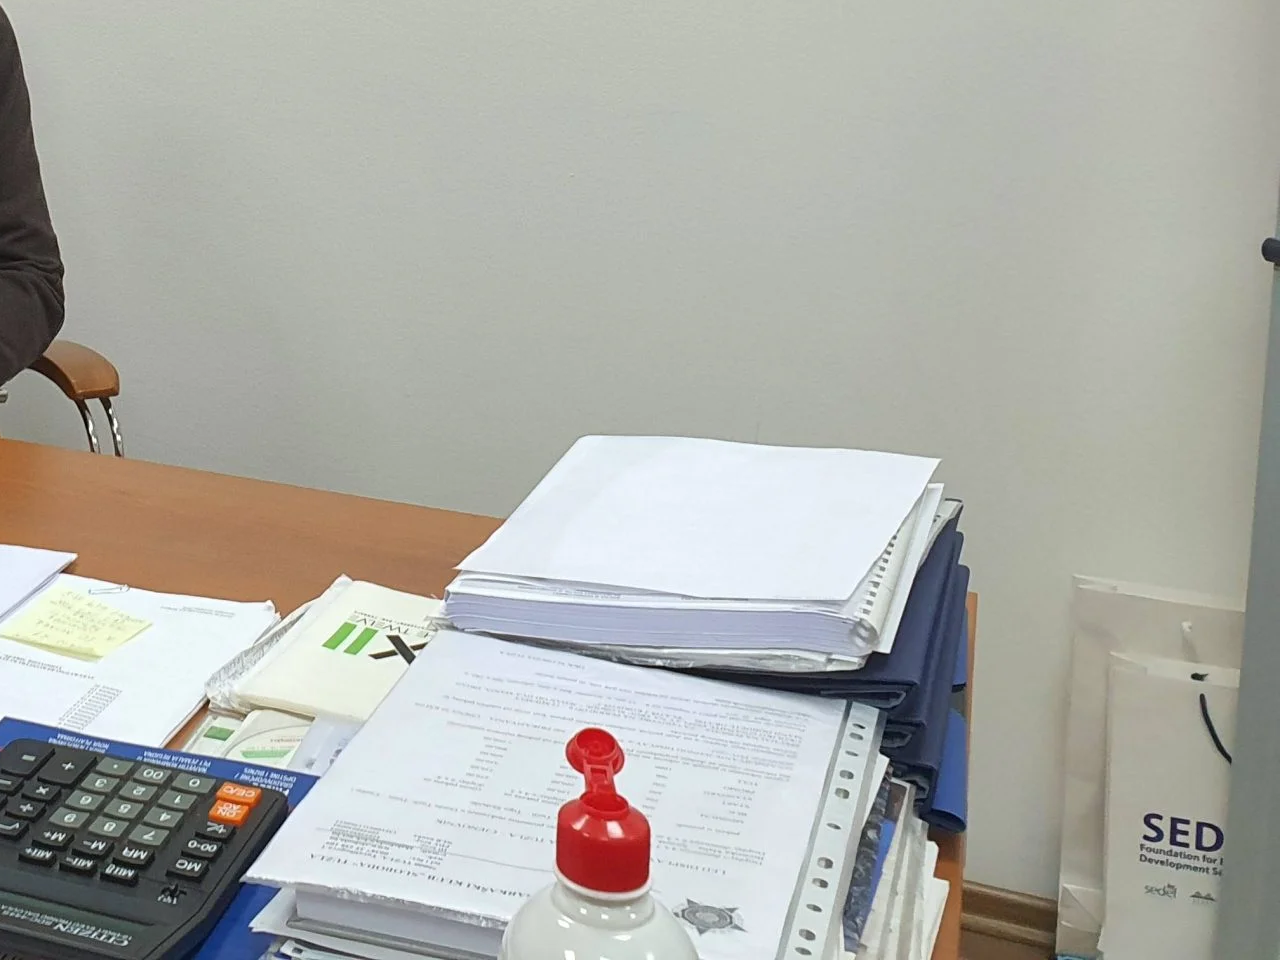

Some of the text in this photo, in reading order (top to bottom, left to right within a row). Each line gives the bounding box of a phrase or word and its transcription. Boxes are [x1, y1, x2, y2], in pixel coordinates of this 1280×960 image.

[143, 769, 164, 780] 00
[94, 778, 107, 788] 3
[189, 778, 200, 788] 0
[132, 786, 146, 796] 2
[80, 795, 92, 805] 6
[174, 795, 181, 804] 1
[118, 803, 131, 814] 5
[64, 813, 77, 823] 9
[159, 811, 171, 821] 4
[103, 821, 116, 832] 8
[143, 830, 156, 840] 7
[122, 846, 148, 860] MR
[1139, 843, 1218, 865] Foundation for
[1139, 853, 1209, 875] Development
[52, 922, 129, 947] CITIZEN
